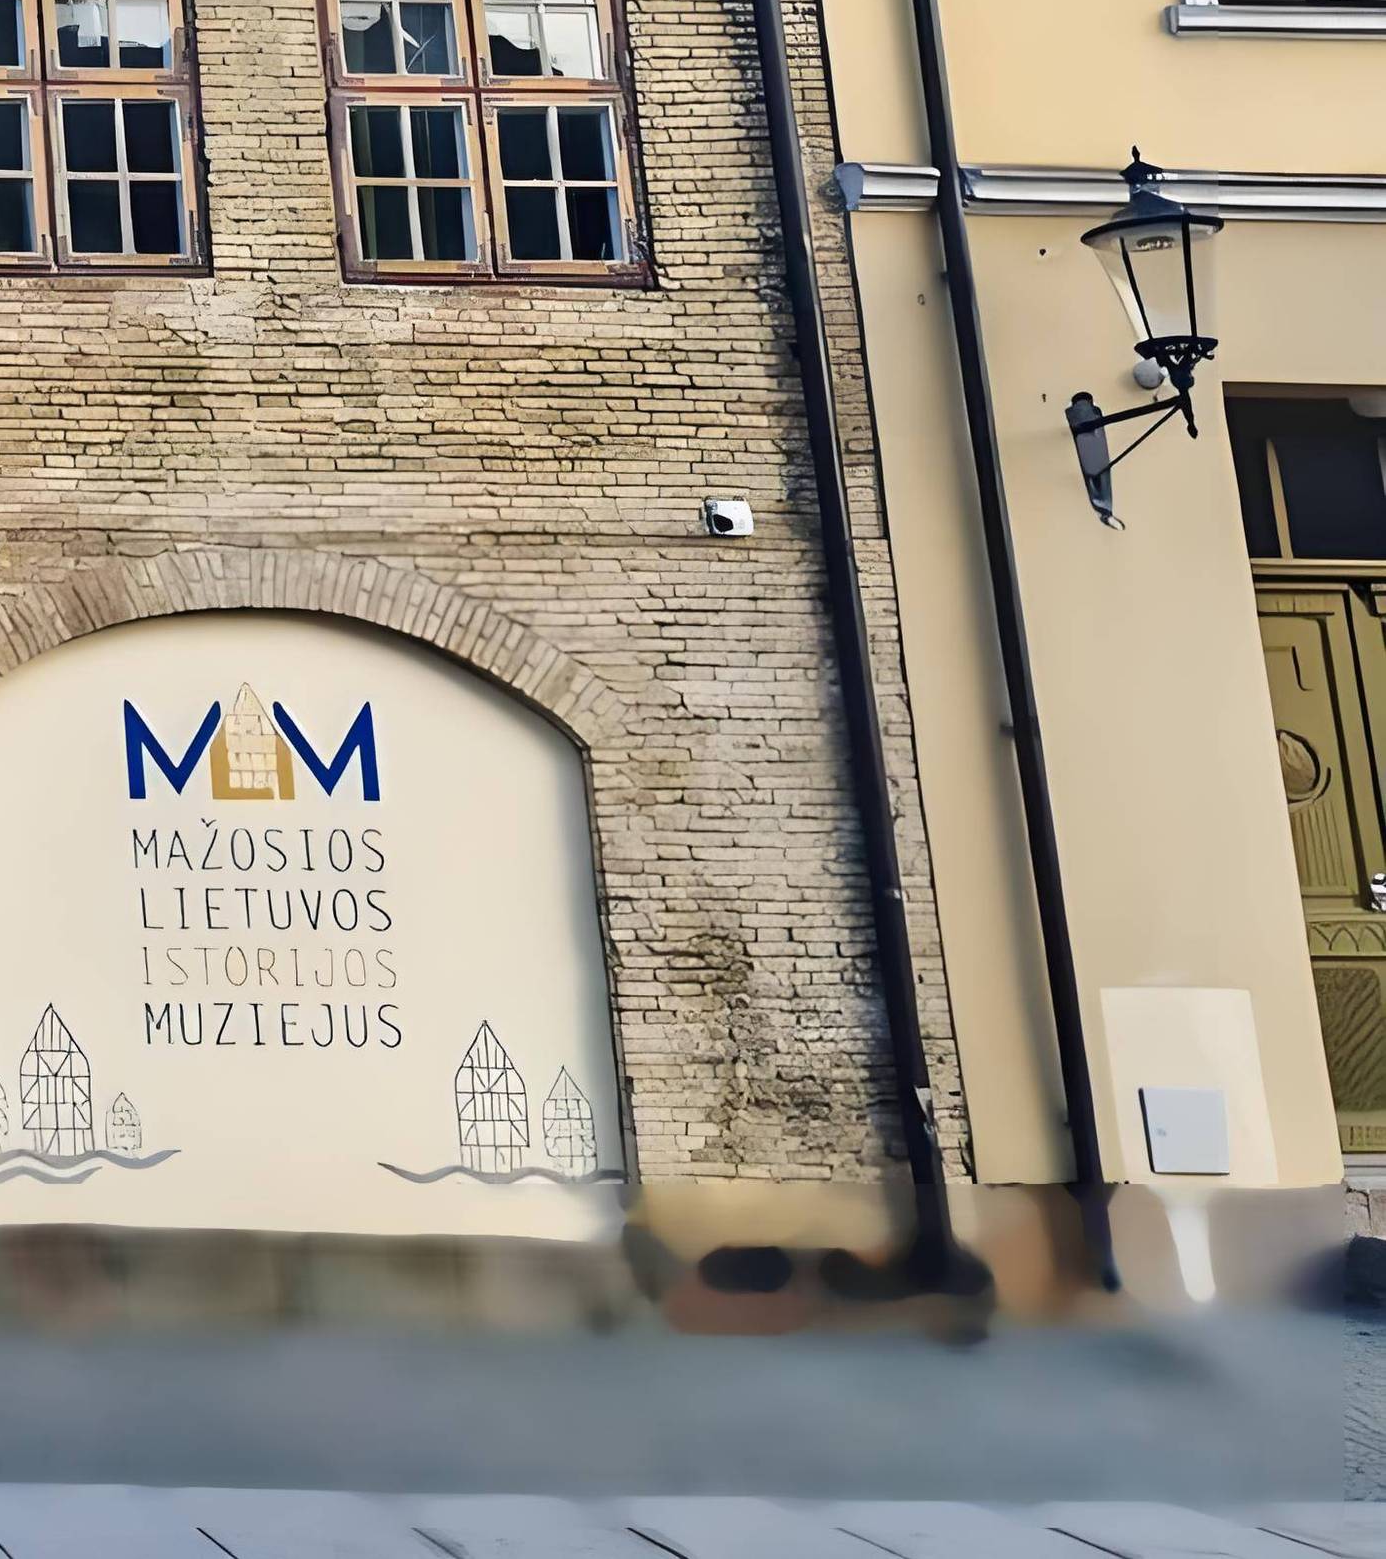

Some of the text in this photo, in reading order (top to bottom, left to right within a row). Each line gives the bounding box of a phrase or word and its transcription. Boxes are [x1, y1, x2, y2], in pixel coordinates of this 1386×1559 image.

[132, 818, 385, 872] MAŽOSIOS
[140, 887, 392, 931] LIETUVOS
[142, 946, 397, 988] ISTORIJOS
[144, 1002, 402, 1048] MUZIEJUS
